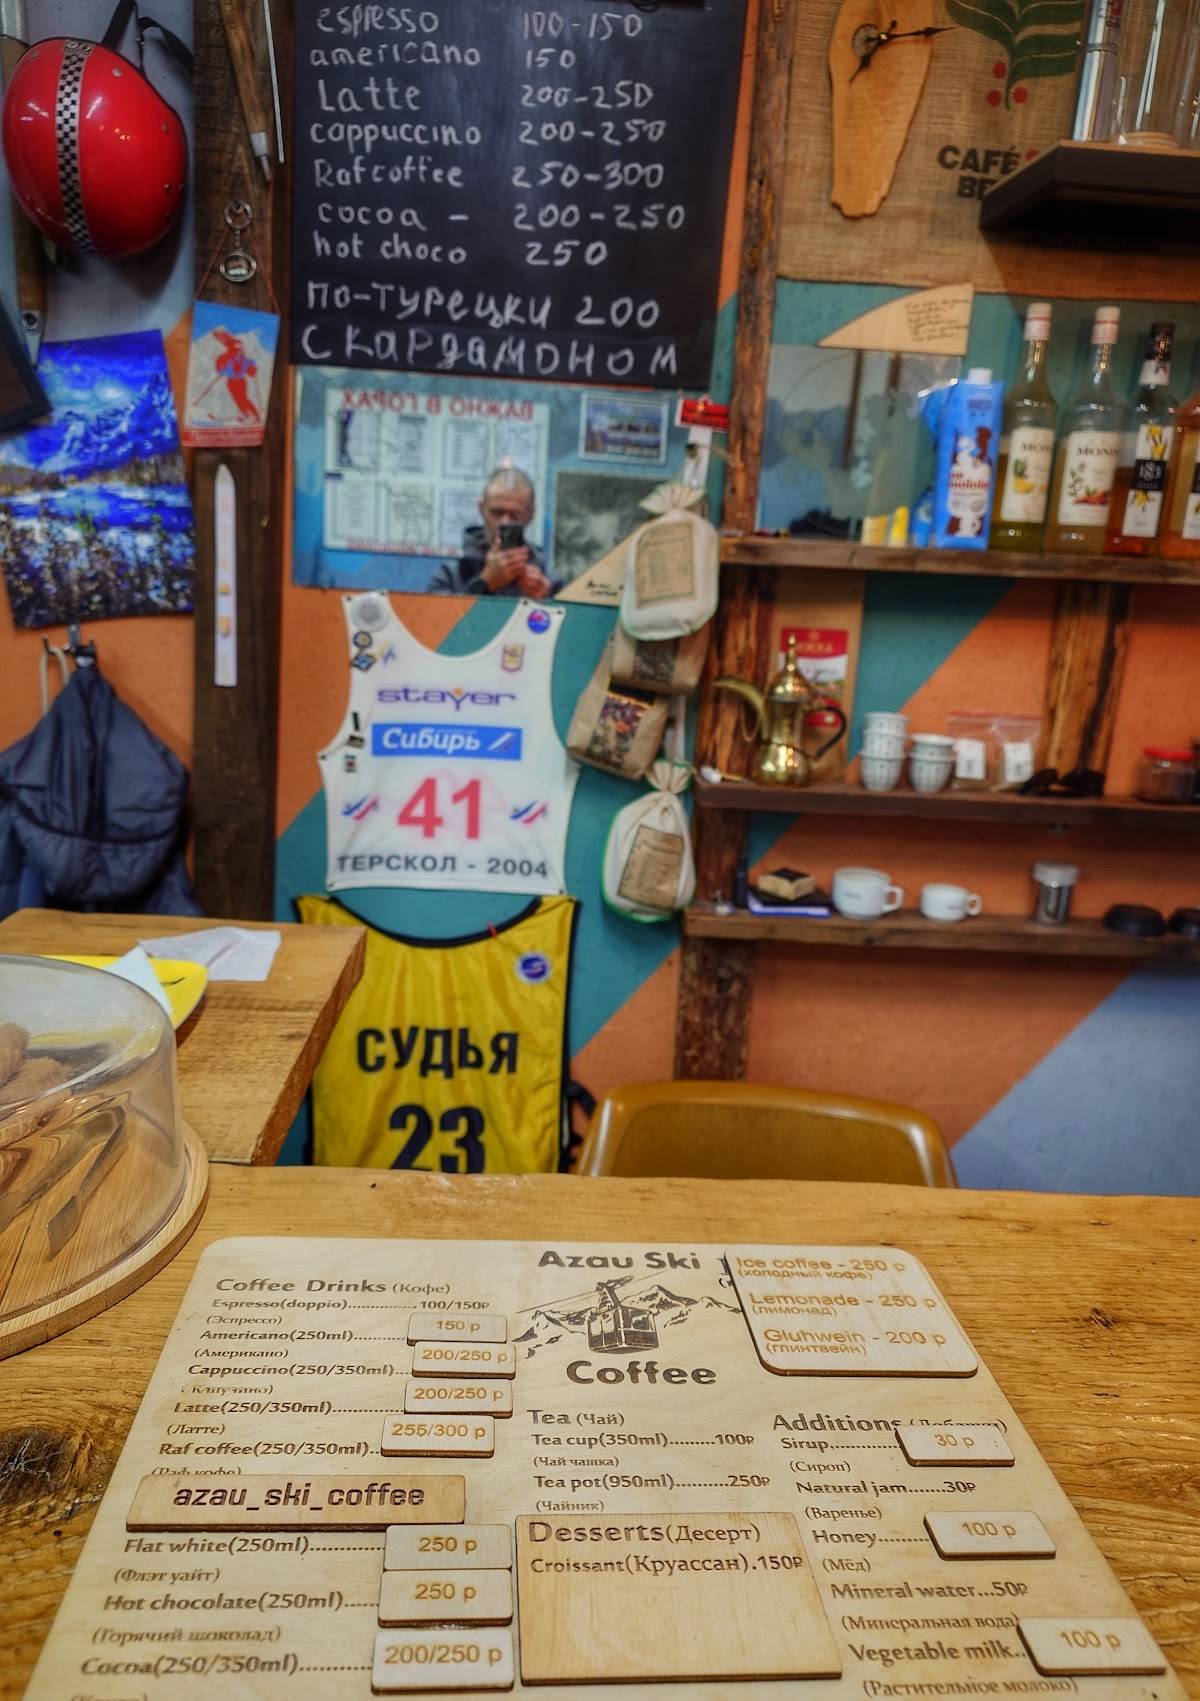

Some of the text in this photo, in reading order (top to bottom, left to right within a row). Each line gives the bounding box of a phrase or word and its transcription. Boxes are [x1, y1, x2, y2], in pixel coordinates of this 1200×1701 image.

[317, 5, 438, 38] espresso
[310, 42, 577, 69] americano 150
[317, 77, 420, 112] Latte
[310, 121, 481, 153] cappuccino
[318, 202, 428, 231] cocoa
[313, 230, 608, 266] hot choco 250
[575, 296, 660, 328] 200
[377, 687, 517, 711] stayer
[382, 728, 481, 754] Сибирь
[398, 776, 482, 840] 41
[338, 855, 456, 874] ТЕРСКОЛ
[487, 858, 548, 879] 2004
[357, 1024, 519, 1079] СУДЬЯ
[389, 1104, 485, 1173] 23
[538, 1250, 701, 1270] Azau Ski
[773, 1258, 831, 1270] coffee
[851, 1259, 888, 1271] 250
[216, 1278, 451, 1295] Coffee Drinks (Кофе)
[750, 1293, 860, 1306] Lemonade
[880, 1295, 917, 1307] 250
[752, 1305, 837, 1316] (лимонад)
[206, 1314, 283, 1326] (Эспрессо)
[436, 1319, 465, 1331] 150
[885, 1331, 926, 1344] 200
[194, 1348, 289, 1360] (Американо)
[422, 1349, 492, 1361] 200/250
[566, 1360, 716, 1385] Coffee
[414, 1387, 486, 1401] 200/250
[527, 1409, 625, 1426] Tea (Чай)
[167, 1424, 225, 1436] (Латте)
[160, 1442, 194, 1455] Raf
[532, 1434, 565, 1446] Tea
[934, 1434, 958, 1447] 30
[533, 1456, 567, 1468] (Чай
[789, 1460, 851, 1474] (Сироп)
[534, 1476, 566, 1488] Tea
[796, 1480, 867, 1494] Natural
[173, 1482, 425, 1511] azau_ski_coffee
[536, 1500, 605, 1512] (Чайник)
[805, 1506, 882, 1520] (Варенье)
[961, 1521, 998, 1536] 100
[124, 1538, 163, 1553] Flat
[418, 1537, 458, 1552] 250
[822, 1557, 871, 1573] (Мёд)
[415, 1583, 455, 1600] 250
[831, 1582, 912, 1600] Mineral
[103, 1593, 147, 1611] Hot
[1060, 1630, 1100, 1648] 100
[384, 1645, 481, 1664] 200/250
[848, 1642, 960, 1667] Vegetable
